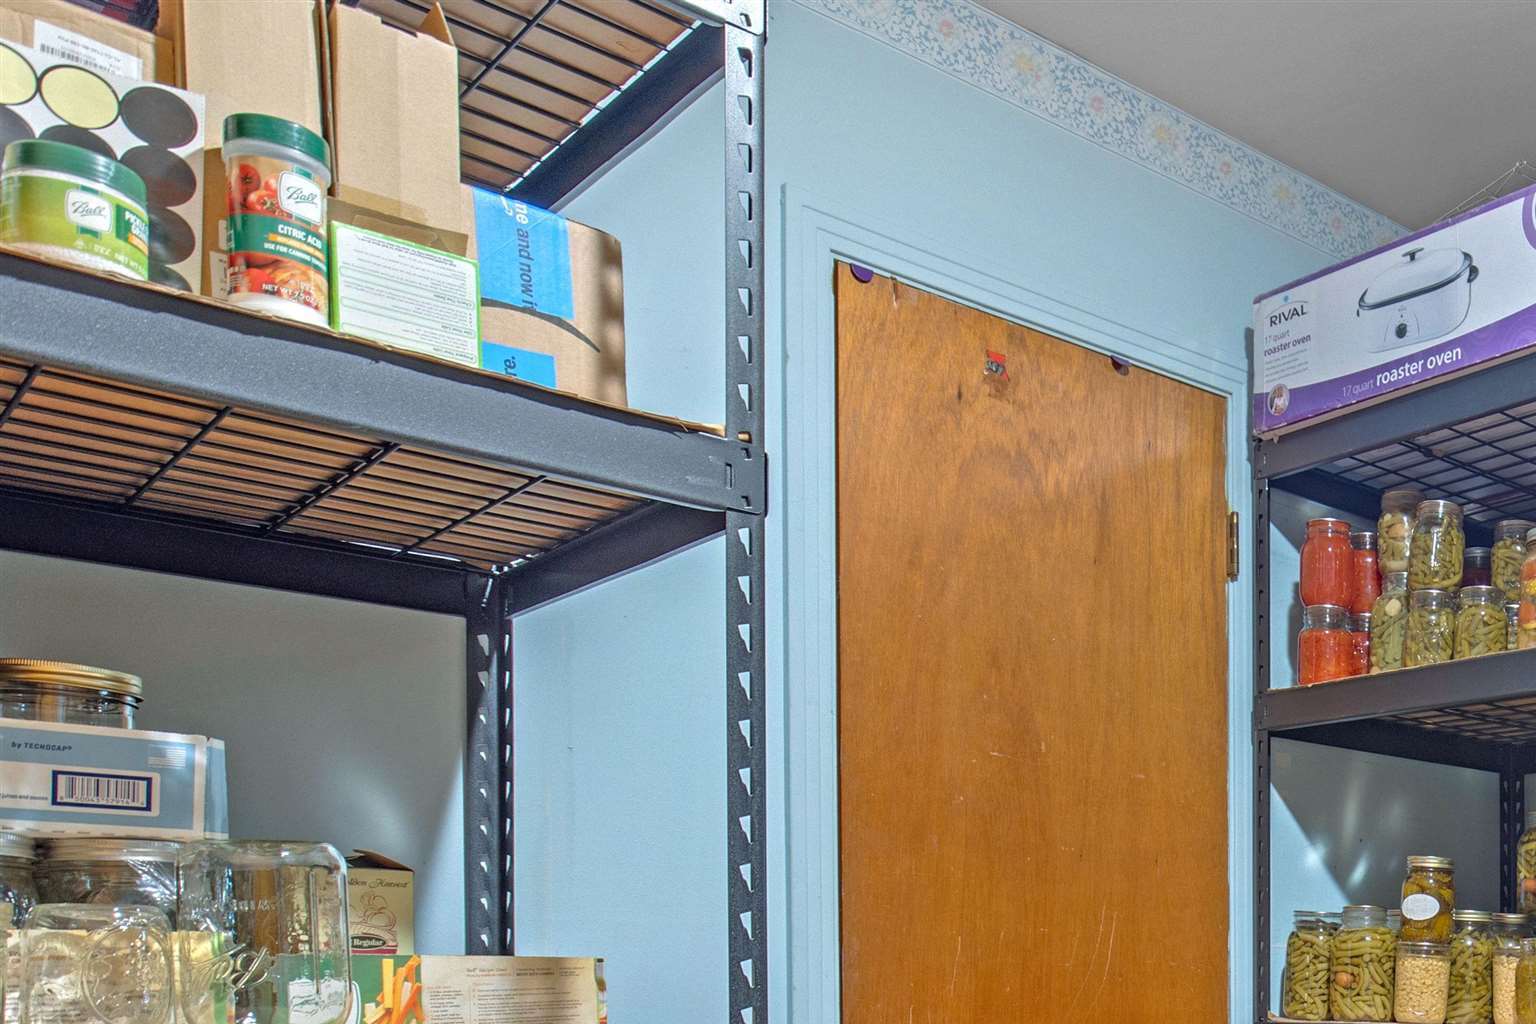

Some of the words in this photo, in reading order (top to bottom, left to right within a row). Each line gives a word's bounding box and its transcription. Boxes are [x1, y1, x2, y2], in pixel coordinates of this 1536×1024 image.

[286, 186, 319, 207] Ball
[277, 223, 307, 241] CITRIC
[516, 228, 535, 262] and
[519, 261, 533, 299] now
[1269, 304, 1308, 327] RIVAL
[1264, 341, 1291, 357] roaster
[1292, 333, 1311, 348] oven
[1376, 358, 1424, 387] roaster
[1426, 347, 1462, 369] oven
[11, 741, 22, 750] by
[352, 938, 383, 947] Regular
